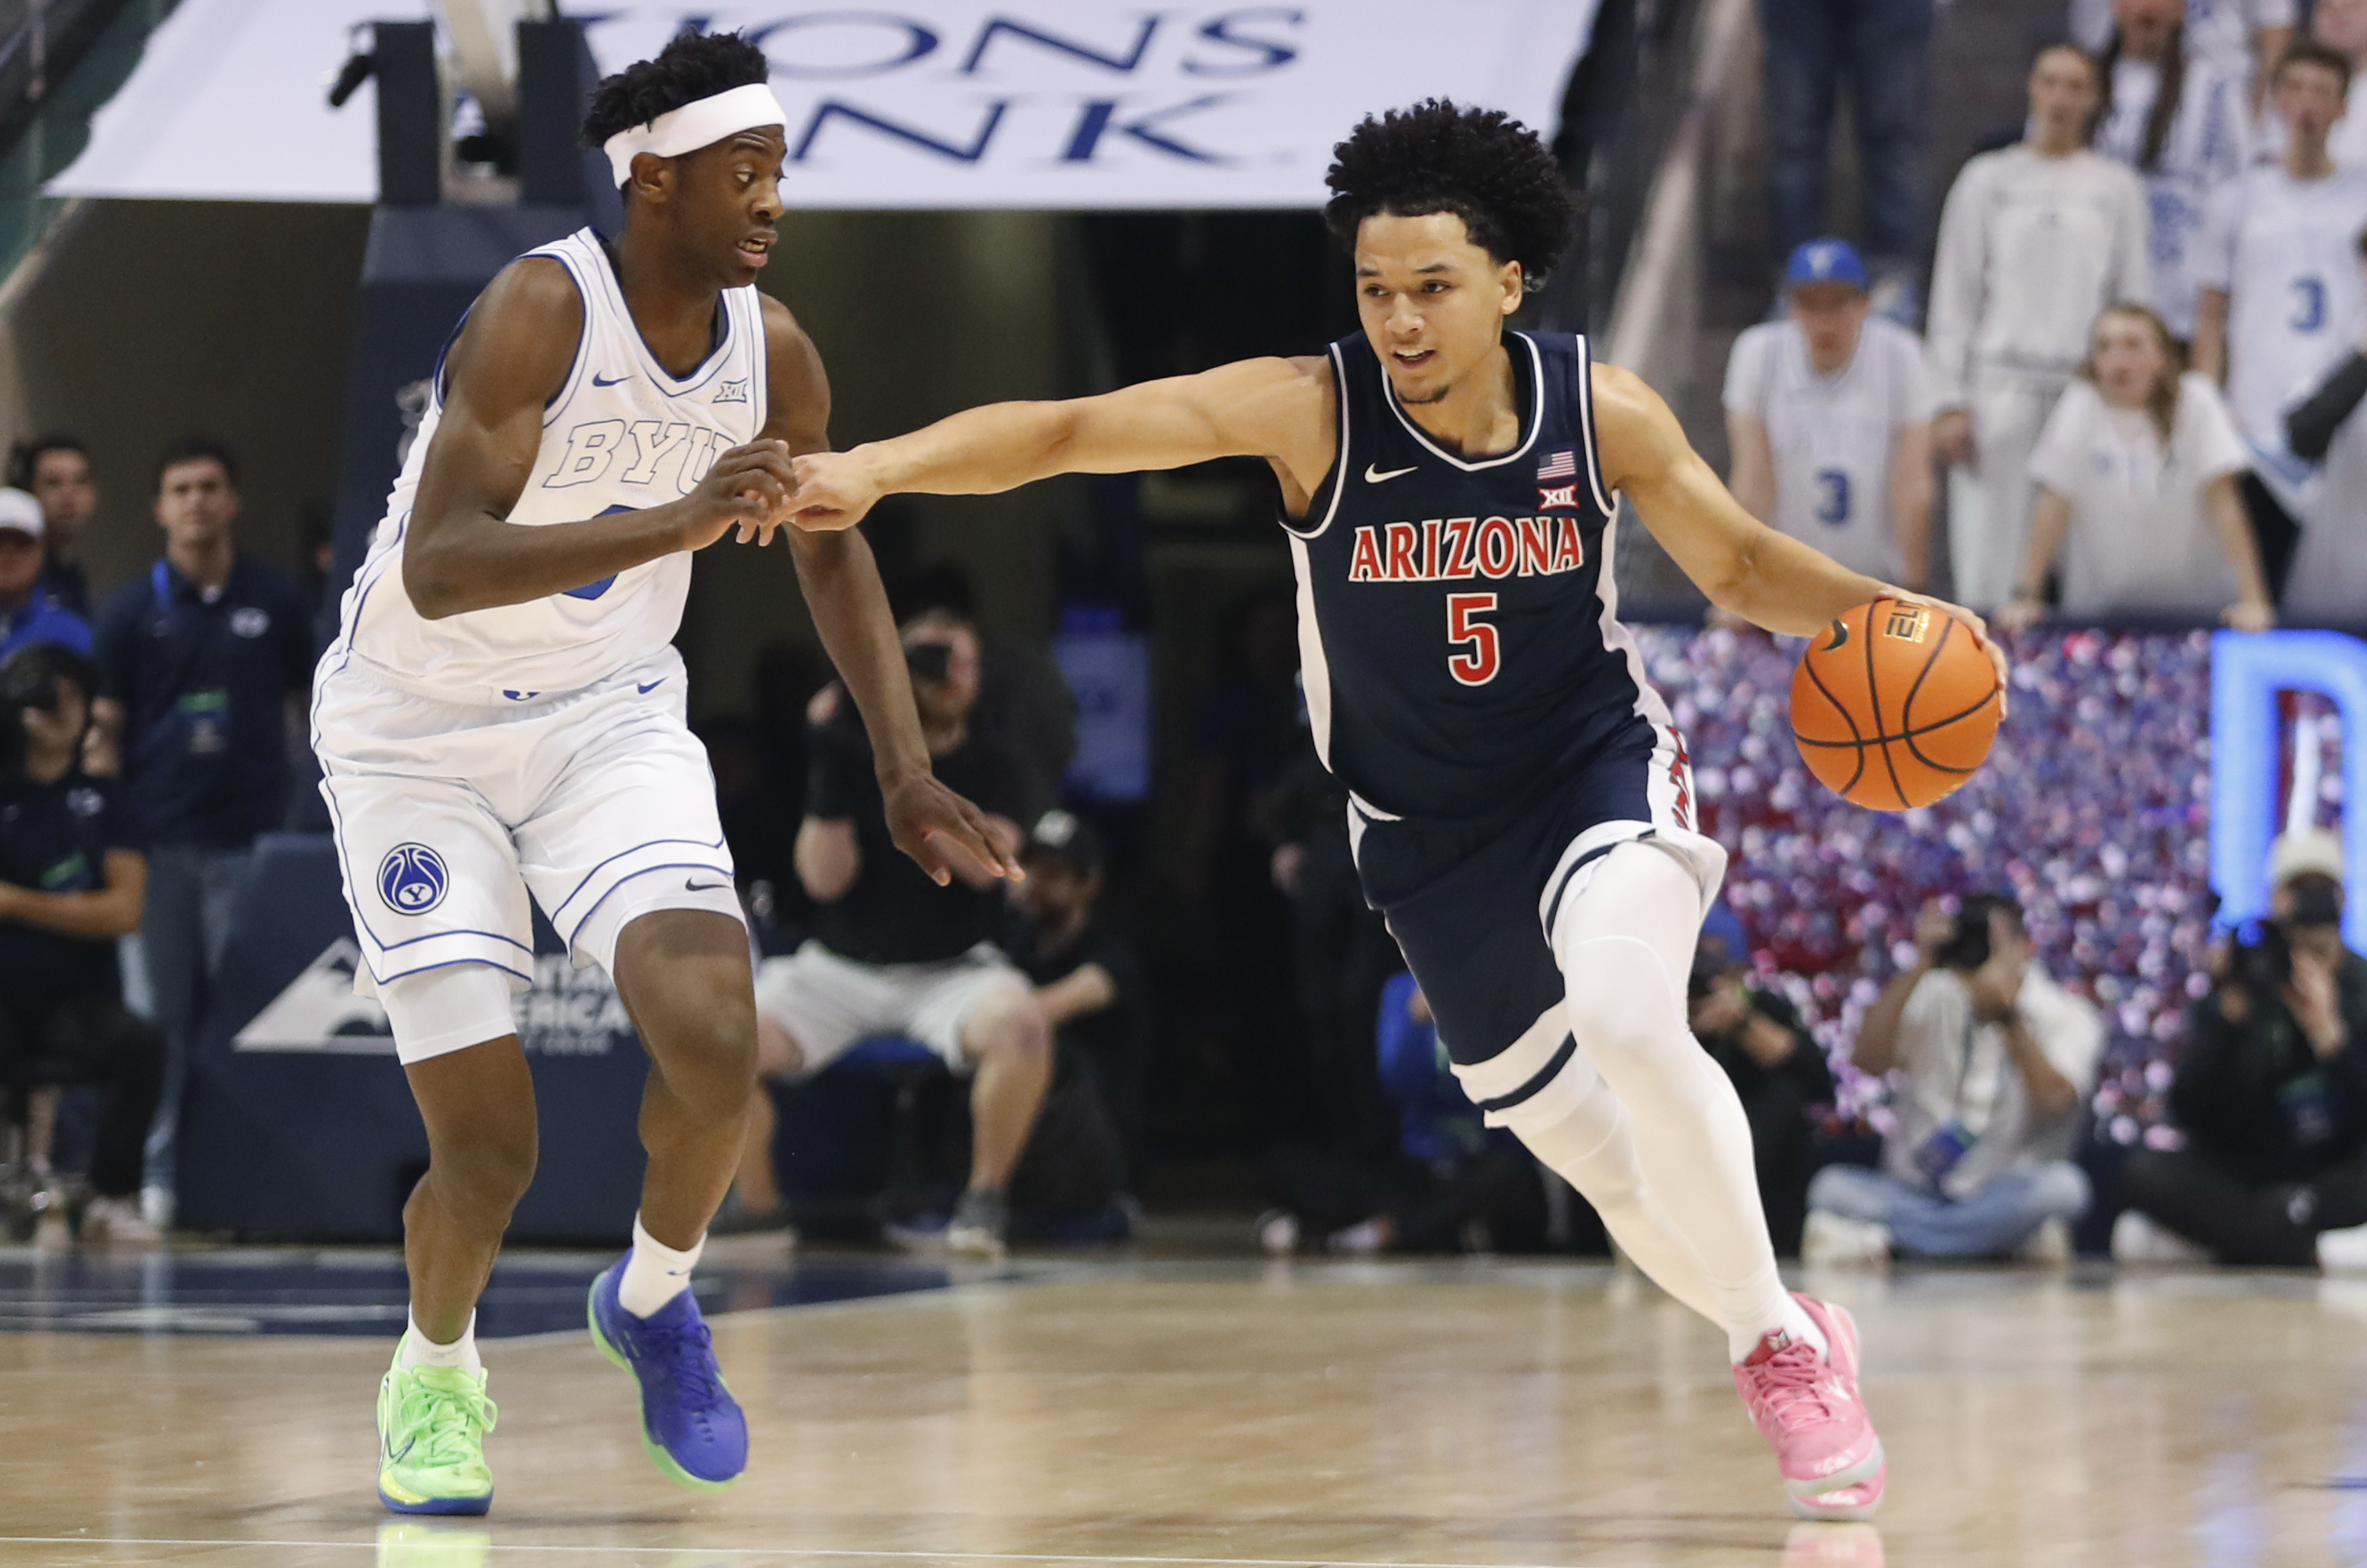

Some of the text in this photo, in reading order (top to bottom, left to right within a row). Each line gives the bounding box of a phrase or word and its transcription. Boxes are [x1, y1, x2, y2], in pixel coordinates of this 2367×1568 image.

[677, 6, 1304, 77] ONS
[786, 92, 1256, 167] NK
[2287, 276, 2328, 332] 3
[542, 420, 736, 495] BYU
[1537, 483, 1581, 511] XII
[1815, 468, 1851, 525] 3
[1348, 516, 1584, 582] ARIZONA
[1447, 592, 1500, 686] 5
[1884, 600, 1921, 642] ELI
[512, 993, 633, 1037] ERICA
